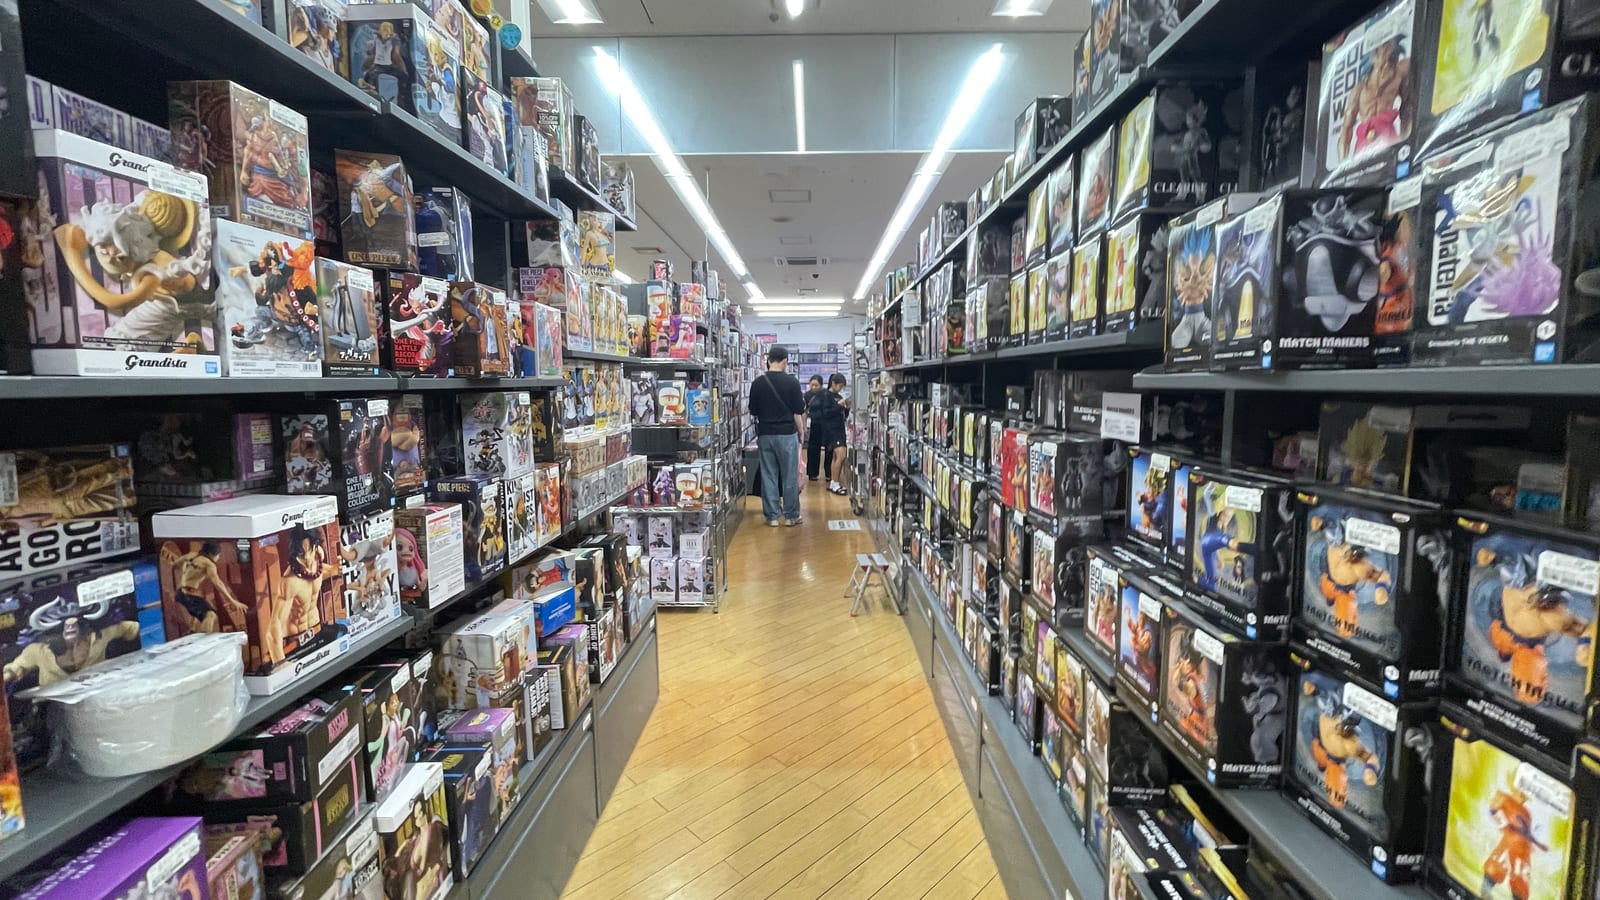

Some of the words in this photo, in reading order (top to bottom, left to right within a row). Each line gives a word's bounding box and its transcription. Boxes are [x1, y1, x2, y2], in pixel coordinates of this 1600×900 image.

[1279, 337, 1321, 349] MATCH
[1322, 336, 1369, 348] MAKERS
[1478, 334, 1510, 344] VEGETA
[125, 354, 188, 371] Grandista
[346, 476, 358, 485] ONE
[437, 483, 451, 492] ONE
[348, 492, 380, 508] COLLECTION
[295, 650, 331, 678] Grandista
[1222, 763, 1256, 773] MATCH
